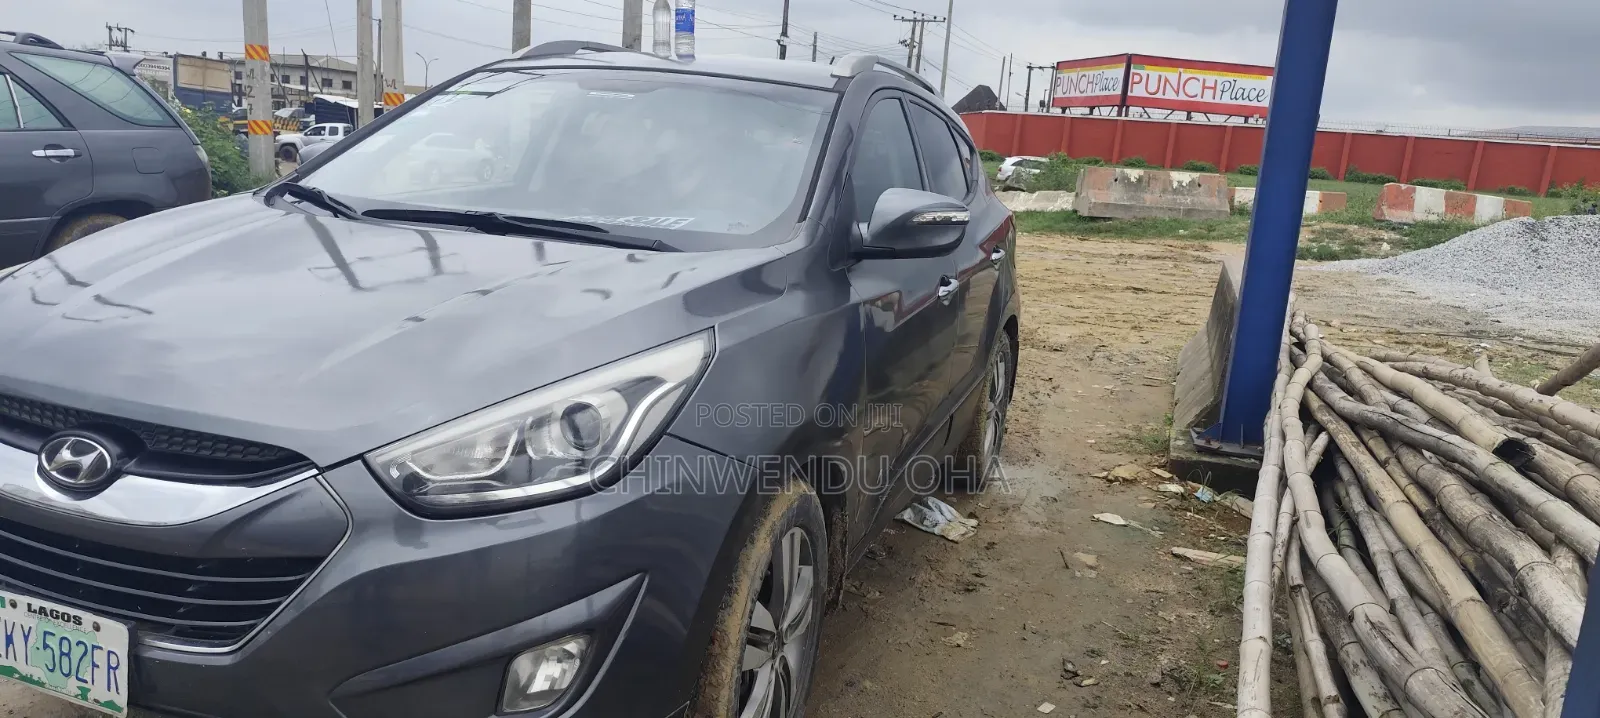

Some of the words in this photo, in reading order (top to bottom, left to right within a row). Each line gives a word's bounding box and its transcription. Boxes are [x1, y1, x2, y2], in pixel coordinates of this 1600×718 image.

[1055, 69, 1096, 95] PUNCH
[1094, 71, 1119, 93] Place
[1130, 70, 1218, 100] PUNCH
[1219, 79, 1268, 102] Place
[27, 602, 83, 626] LAGOS
